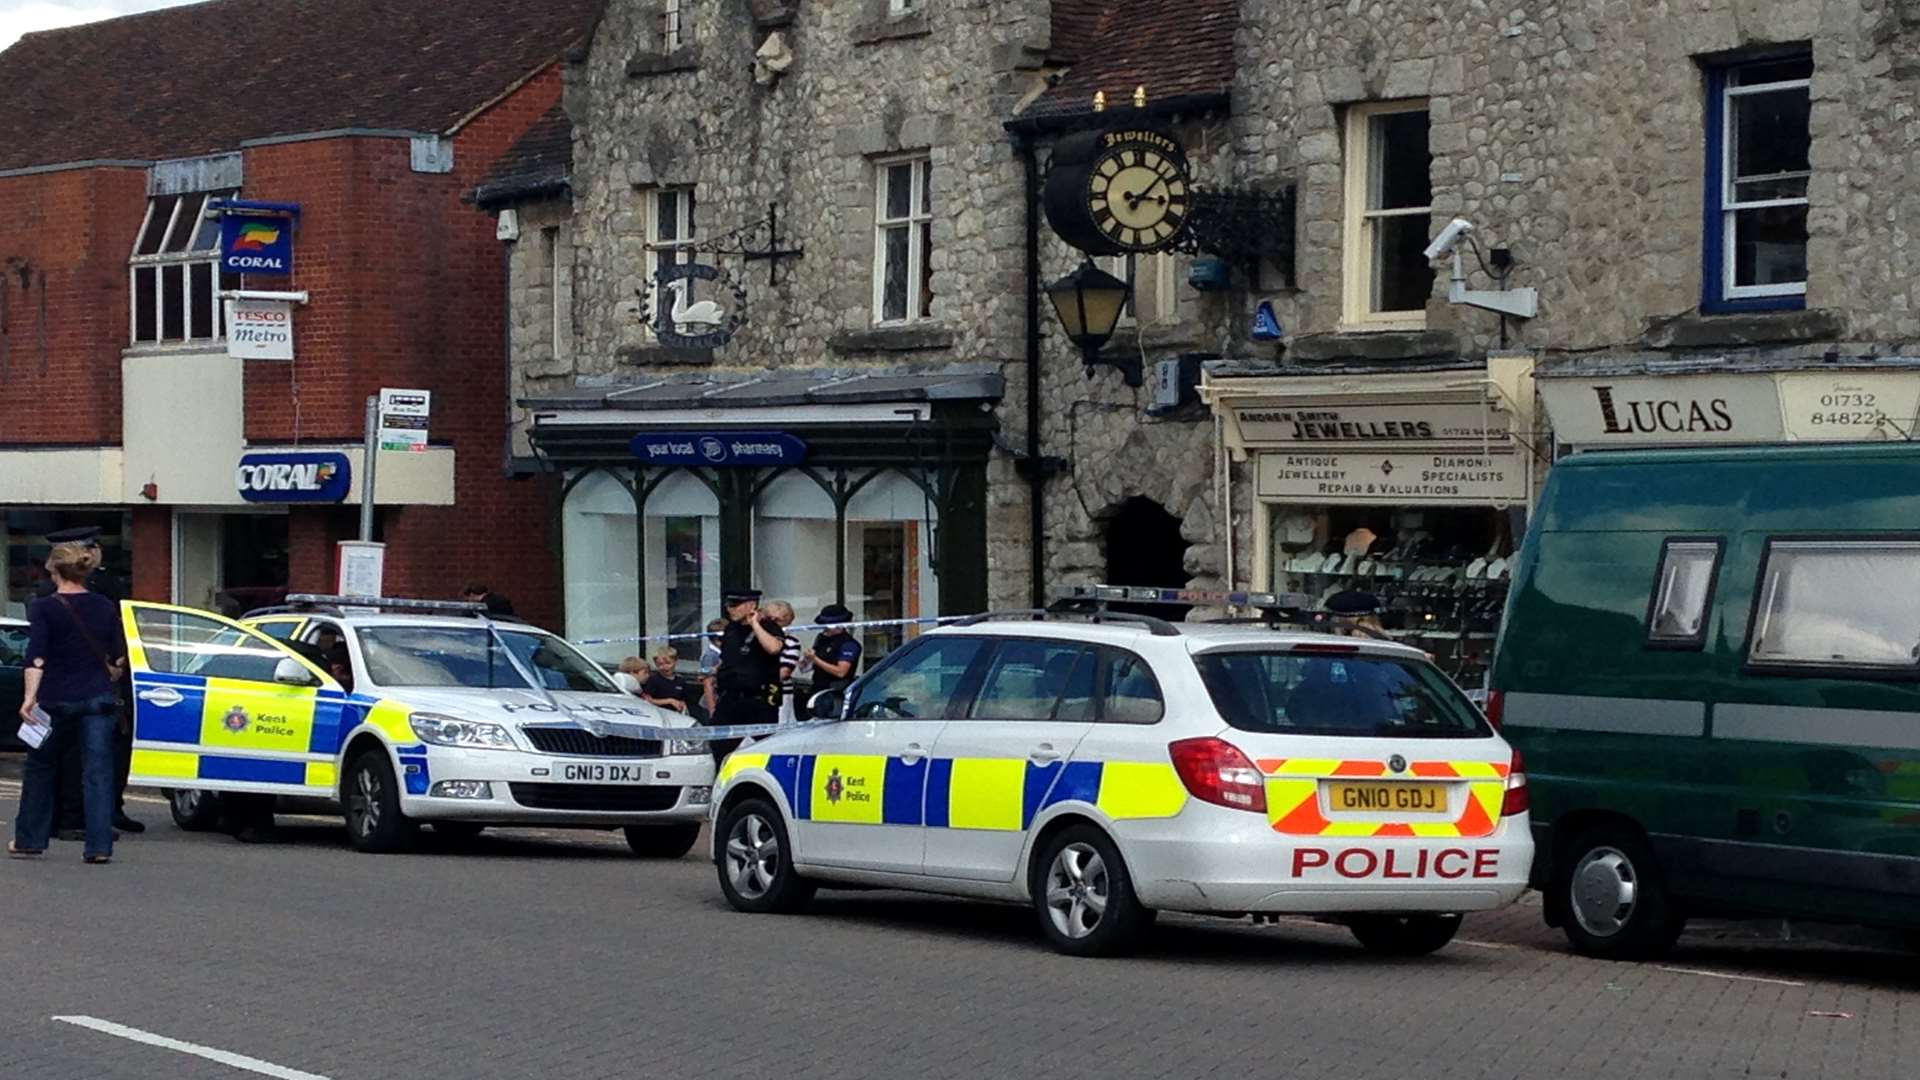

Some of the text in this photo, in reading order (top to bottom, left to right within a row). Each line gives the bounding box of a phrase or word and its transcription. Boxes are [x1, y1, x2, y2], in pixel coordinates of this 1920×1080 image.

[1104, 131, 1175, 151] Jewellers
[228, 256, 282, 268] CORAL
[235, 312, 285, 321] TESCO
[235, 329, 287, 342] Metro
[1820, 394, 1876, 407] 01732
[1592, 385, 1733, 434] LUCAS
[1292, 421, 1433, 439] JEWELLERS
[647, 443, 668, 457] your
[668, 441, 695, 454] local
[731, 441, 783, 457] pharmacy
[1286, 456, 1339, 467] ANTIQUE
[237, 464, 321, 490] CORAL
[1277, 469, 1346, 480] JEWELLERY
[1422, 470, 1504, 482] SPECIALISTS
[1318, 483, 1459, 494] REPAIR & VALUATIONS
[256, 713, 287, 724] Kent
[255, 725, 294, 736] Police
[564, 765, 641, 781] GN13 DXJ
[847, 776, 865, 786] Kent
[846, 791, 870, 802] Police
[1343, 788, 1436, 809] GN10 GDJ
[1291, 848, 1500, 878] POLICE
